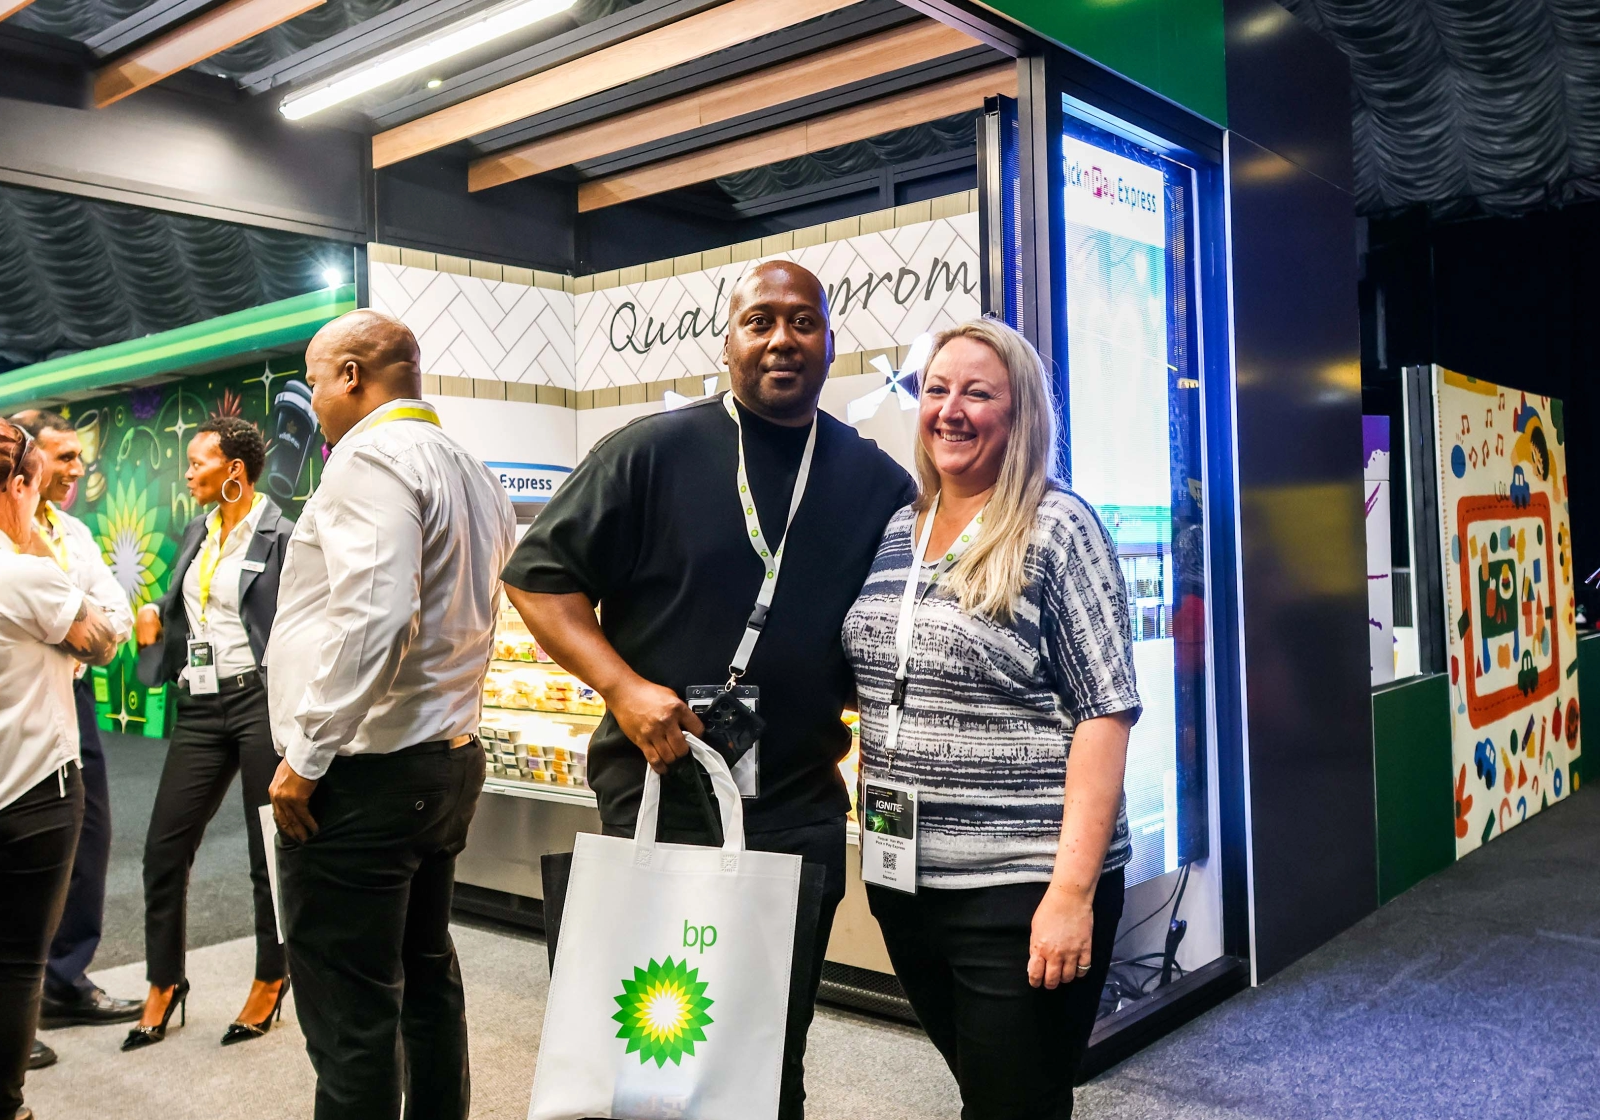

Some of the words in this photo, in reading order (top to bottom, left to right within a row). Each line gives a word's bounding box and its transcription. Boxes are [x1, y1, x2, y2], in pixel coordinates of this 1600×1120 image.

[1117, 176, 1157, 214] Express
[499, 473, 553, 492] Express
[875, 799, 903, 814] IGNITE
[682, 919, 718, 954] bp
